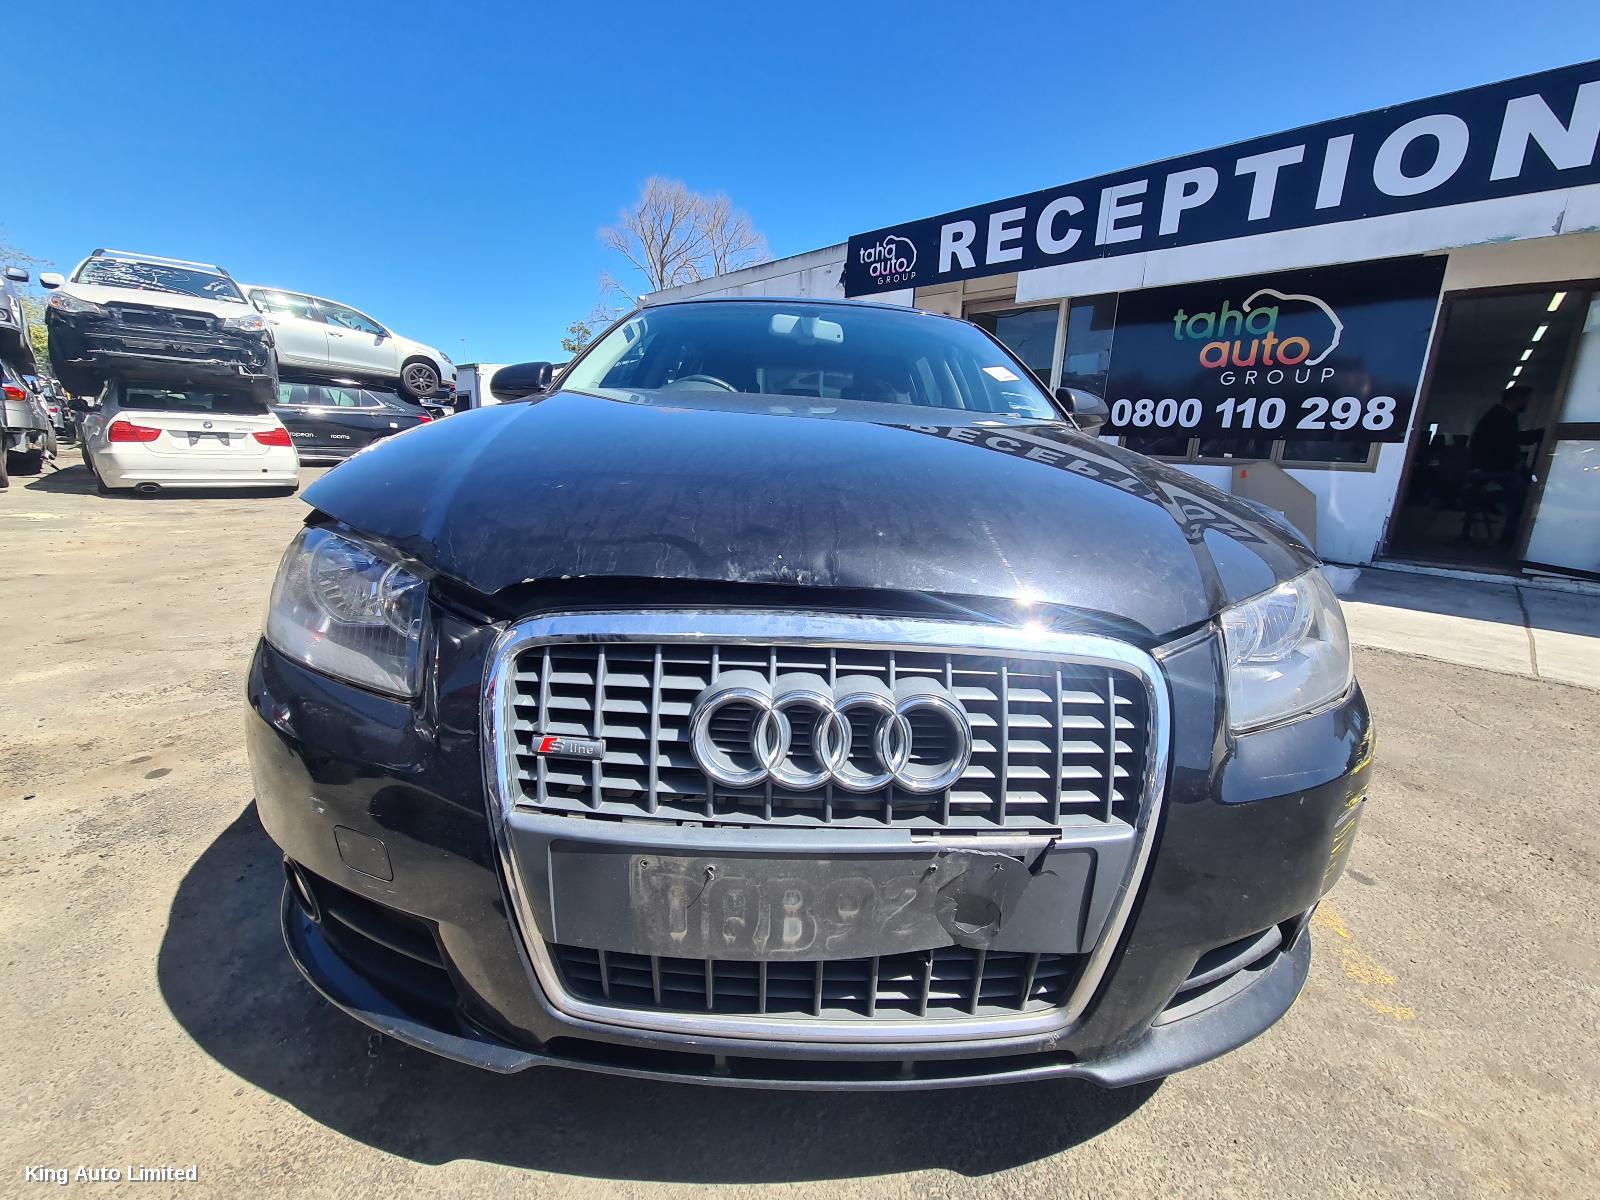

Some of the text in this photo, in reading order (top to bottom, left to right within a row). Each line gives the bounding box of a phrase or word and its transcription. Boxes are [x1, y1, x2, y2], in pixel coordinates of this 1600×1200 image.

[938, 80, 1600, 275] RECEPTION
[859, 241, 896, 264] taha
[869, 257, 907, 277] auto
[877, 271, 916, 285] GROUP
[1173, 300, 1279, 341] taha
[1199, 331, 1311, 369] auto
[1220, 367, 1336, 386] GROUP
[1110, 396, 1397, 431] 0800 110 298
[569, 742, 594, 755] line
